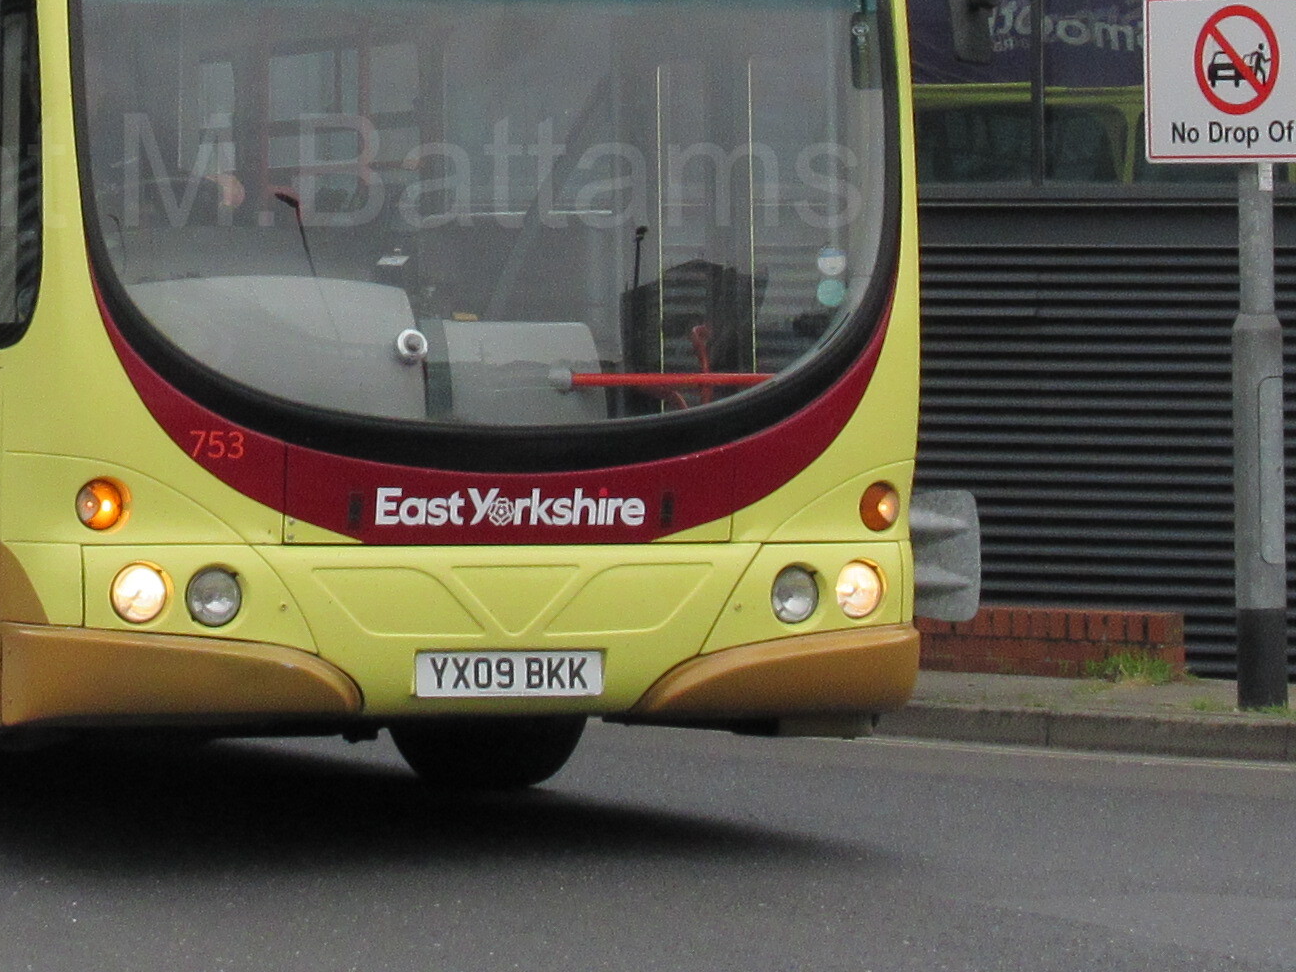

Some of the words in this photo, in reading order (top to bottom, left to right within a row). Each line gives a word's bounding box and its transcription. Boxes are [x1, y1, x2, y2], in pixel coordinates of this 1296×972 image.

[1171, 120, 1200, 144] No
[1207, 120, 1260, 149] Drop
[189, 430, 245, 459] 753
[375, 486, 466, 526] East
[429, 657, 516, 690] YX09
[524, 657, 589, 690] BKK
